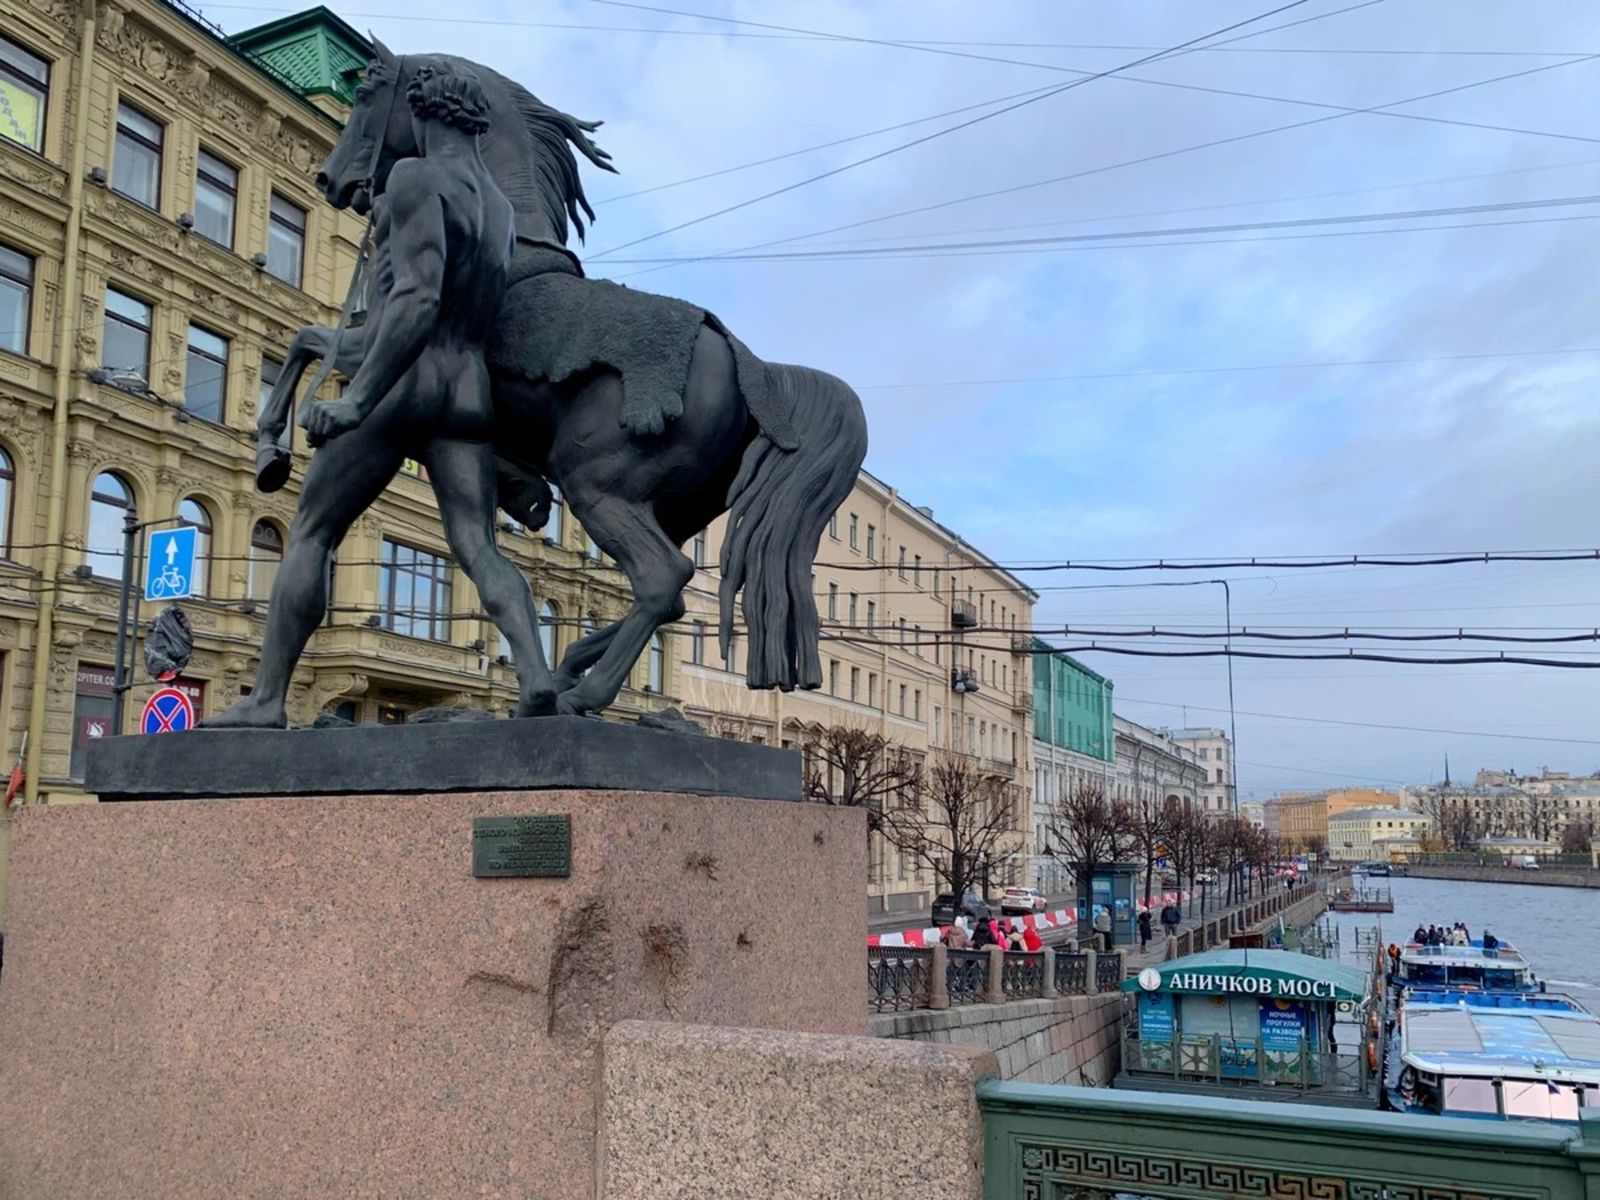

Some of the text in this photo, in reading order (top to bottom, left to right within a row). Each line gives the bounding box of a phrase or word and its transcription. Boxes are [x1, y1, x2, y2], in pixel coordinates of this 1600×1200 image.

[1169, 973, 1338, 998] АНИЧКОВ МОСТ
[1269, 1011, 1297, 1019] НОЧНЫЕ
[1266, 1019, 1301, 1028] ПРОГУЛКИ
